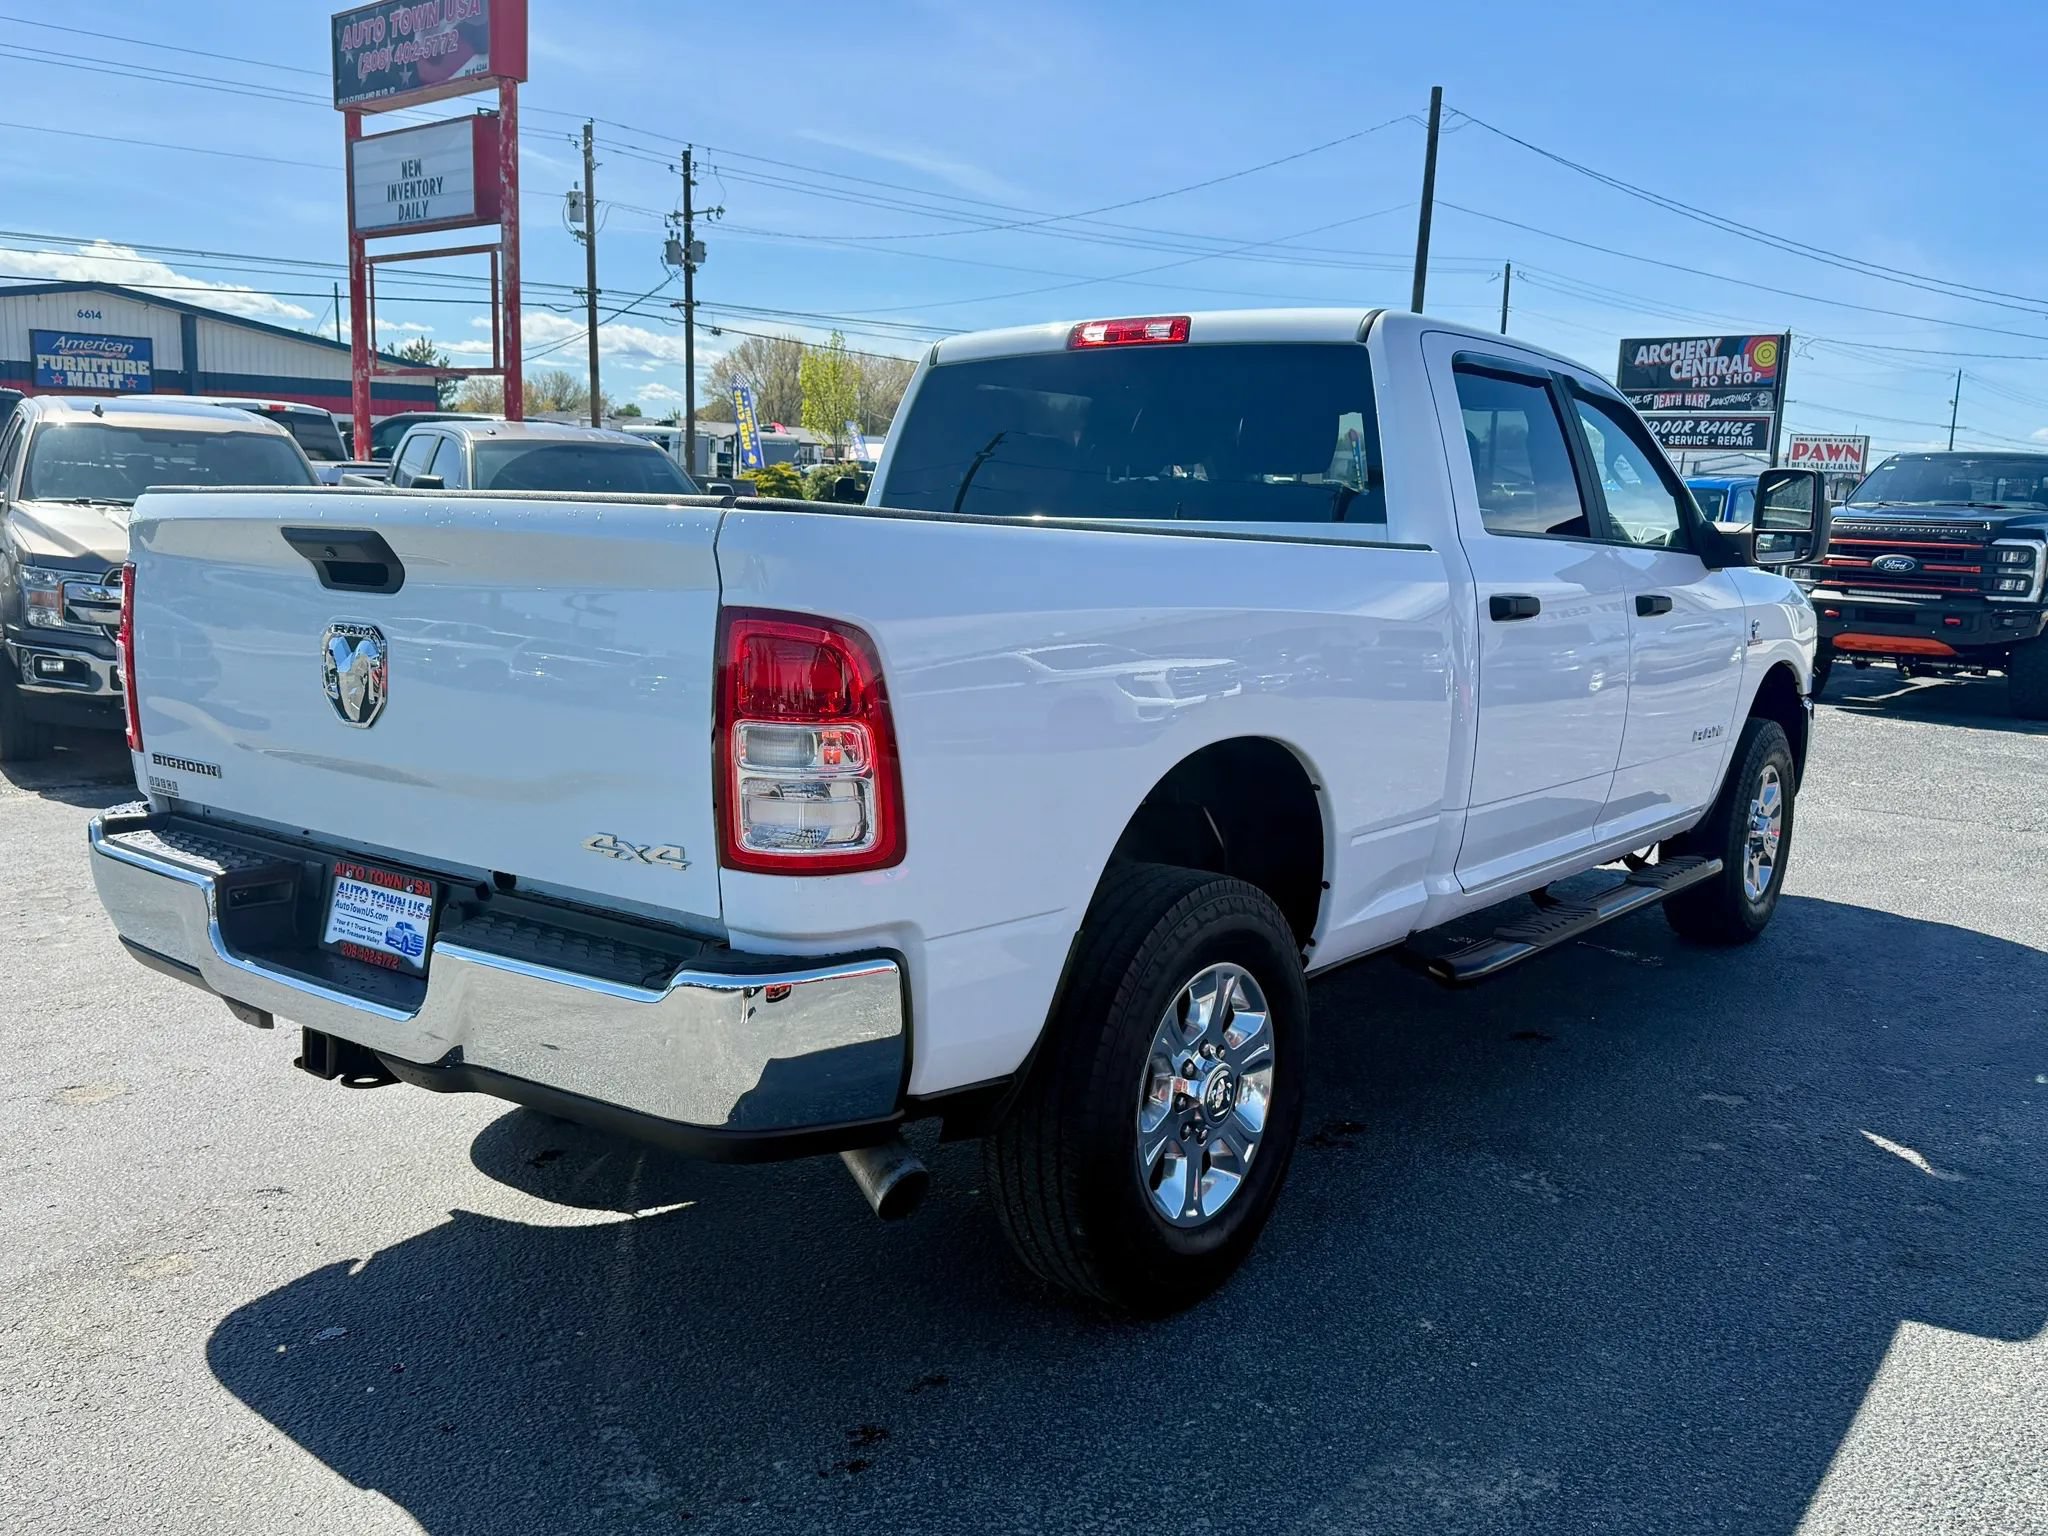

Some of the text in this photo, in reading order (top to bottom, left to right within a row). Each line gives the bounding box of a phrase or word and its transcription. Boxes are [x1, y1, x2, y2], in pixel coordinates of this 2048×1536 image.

[341, 0, 481, 51] AUTO TOWN USA
[358, 29, 459, 79] (208) 402-5772
[401, 159, 422, 179] NEW
[387, 176, 444, 203] INVENTORY
[398, 200, 429, 222] DAILY
[77, 309, 102, 320] 6614
[52, 336, 134, 354] American
[1635, 338, 1722, 366] ARCHERY
[36, 354, 150, 376] FURNITURE
[1670, 354, 1753, 381] CENTRAL
[67, 372, 123, 389] MART
[1692, 372, 1762, 388] PRO SHOP
[1643, 393, 1654, 404] OF
[1653, 394, 1682, 410] DEATH
[1685, 393, 1711, 408] HARP
[1648, 420, 1756, 436] DOOR RANGE
[1668, 436, 1709, 446] SERVICE
[1717, 436, 1754, 446] REPAIR
[1792, 443, 1862, 463] PAWN
[1884, 560, 1907, 570] Ford
[333, 623, 371, 636] RAM
[152, 753, 218, 777] BIGHORN
[334, 862, 366, 881] AUTO
[370, 869, 403, 889] TOWN
[336, 882, 369, 903] AUTO
[371, 890, 406, 914] TOWN
[335, 899, 389, 922] AutoTownUS.com
